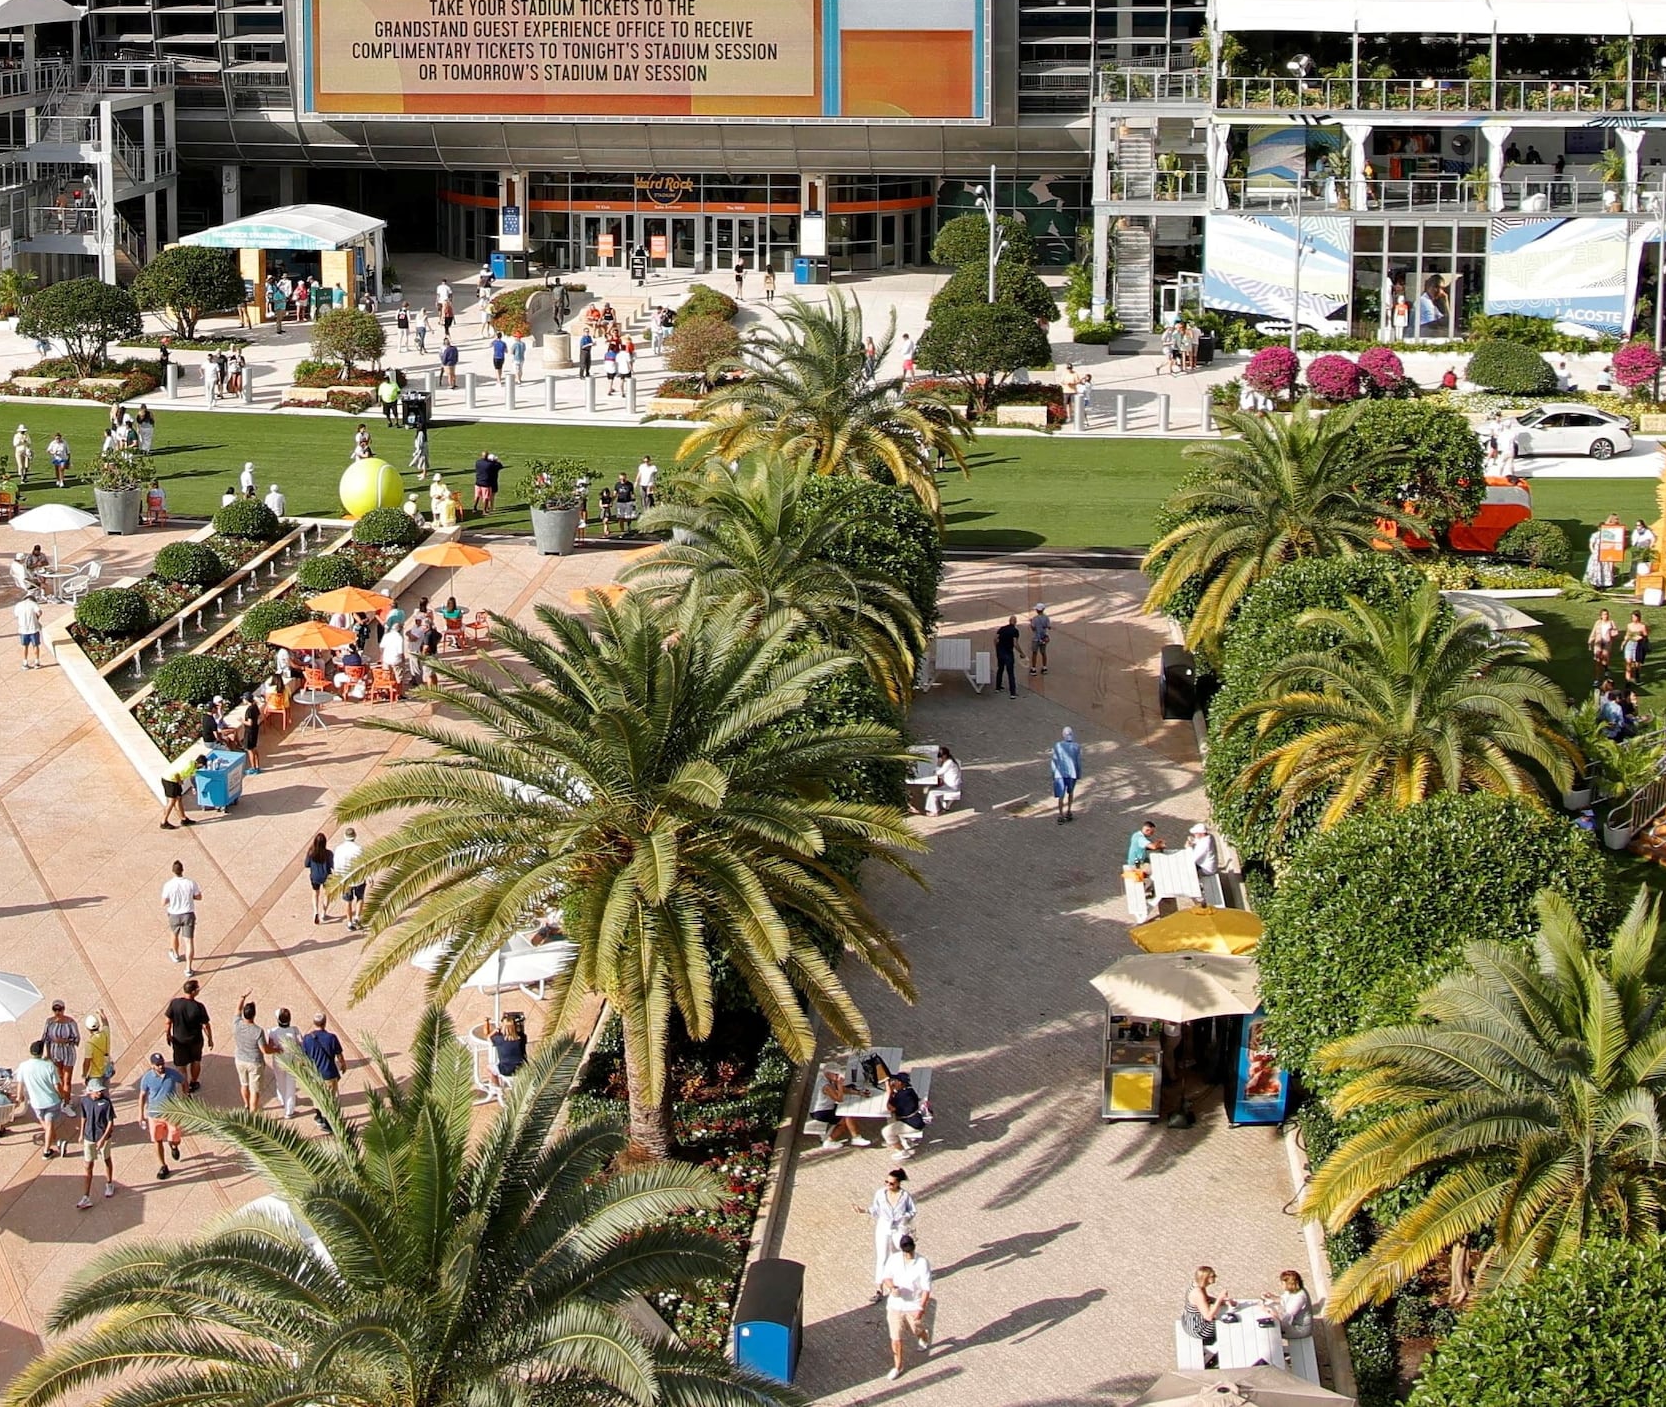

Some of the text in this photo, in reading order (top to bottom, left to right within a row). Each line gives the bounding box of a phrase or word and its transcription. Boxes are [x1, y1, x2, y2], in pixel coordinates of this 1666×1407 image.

[429, 0, 464, 16] TAKE
[469, 0, 506, 16] YOUR
[511, 0, 575, 16] STADIUM
[375, 20, 754, 38] GRANDSTAND GUEST EXPERIENCE OFFICE TO RECEIVE
[352, 41, 778, 60] COMPLIMENTARY TICKETS TO TONIGHT'S STADIUM SESSION
[419, 63, 707, 82] OR TOMORROW'S STADIUM DAY SESSION
[634, 176, 694, 192] Hard Rock
[1555, 307, 1622, 324] LACOSTE
